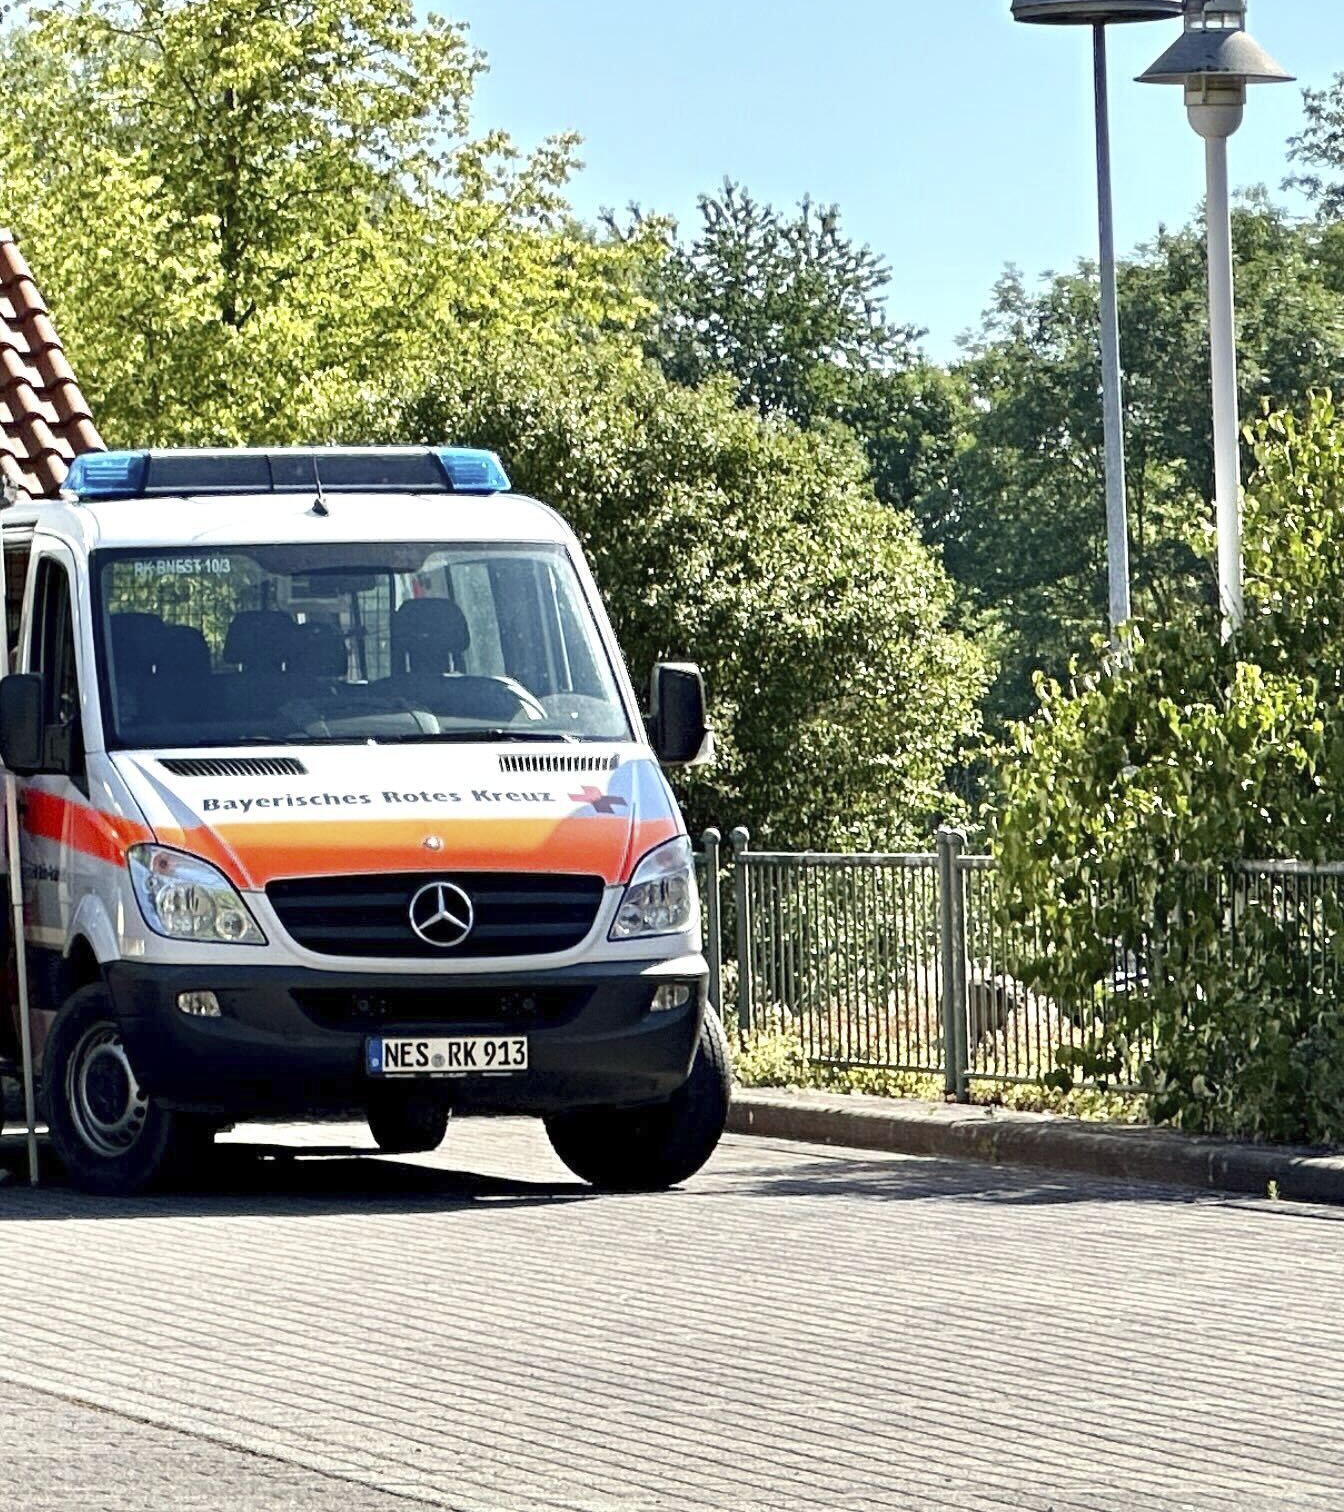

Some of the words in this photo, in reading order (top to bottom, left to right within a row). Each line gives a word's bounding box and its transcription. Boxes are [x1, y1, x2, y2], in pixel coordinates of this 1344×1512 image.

[202, 793, 372, 813] Bayerisches
[381, 791, 462, 804] Rotes
[470, 789, 556, 803] Kreuz
[384, 1042, 429, 1068] NES
[448, 1041, 477, 1067] RK
[484, 1040, 525, 1066] 913
